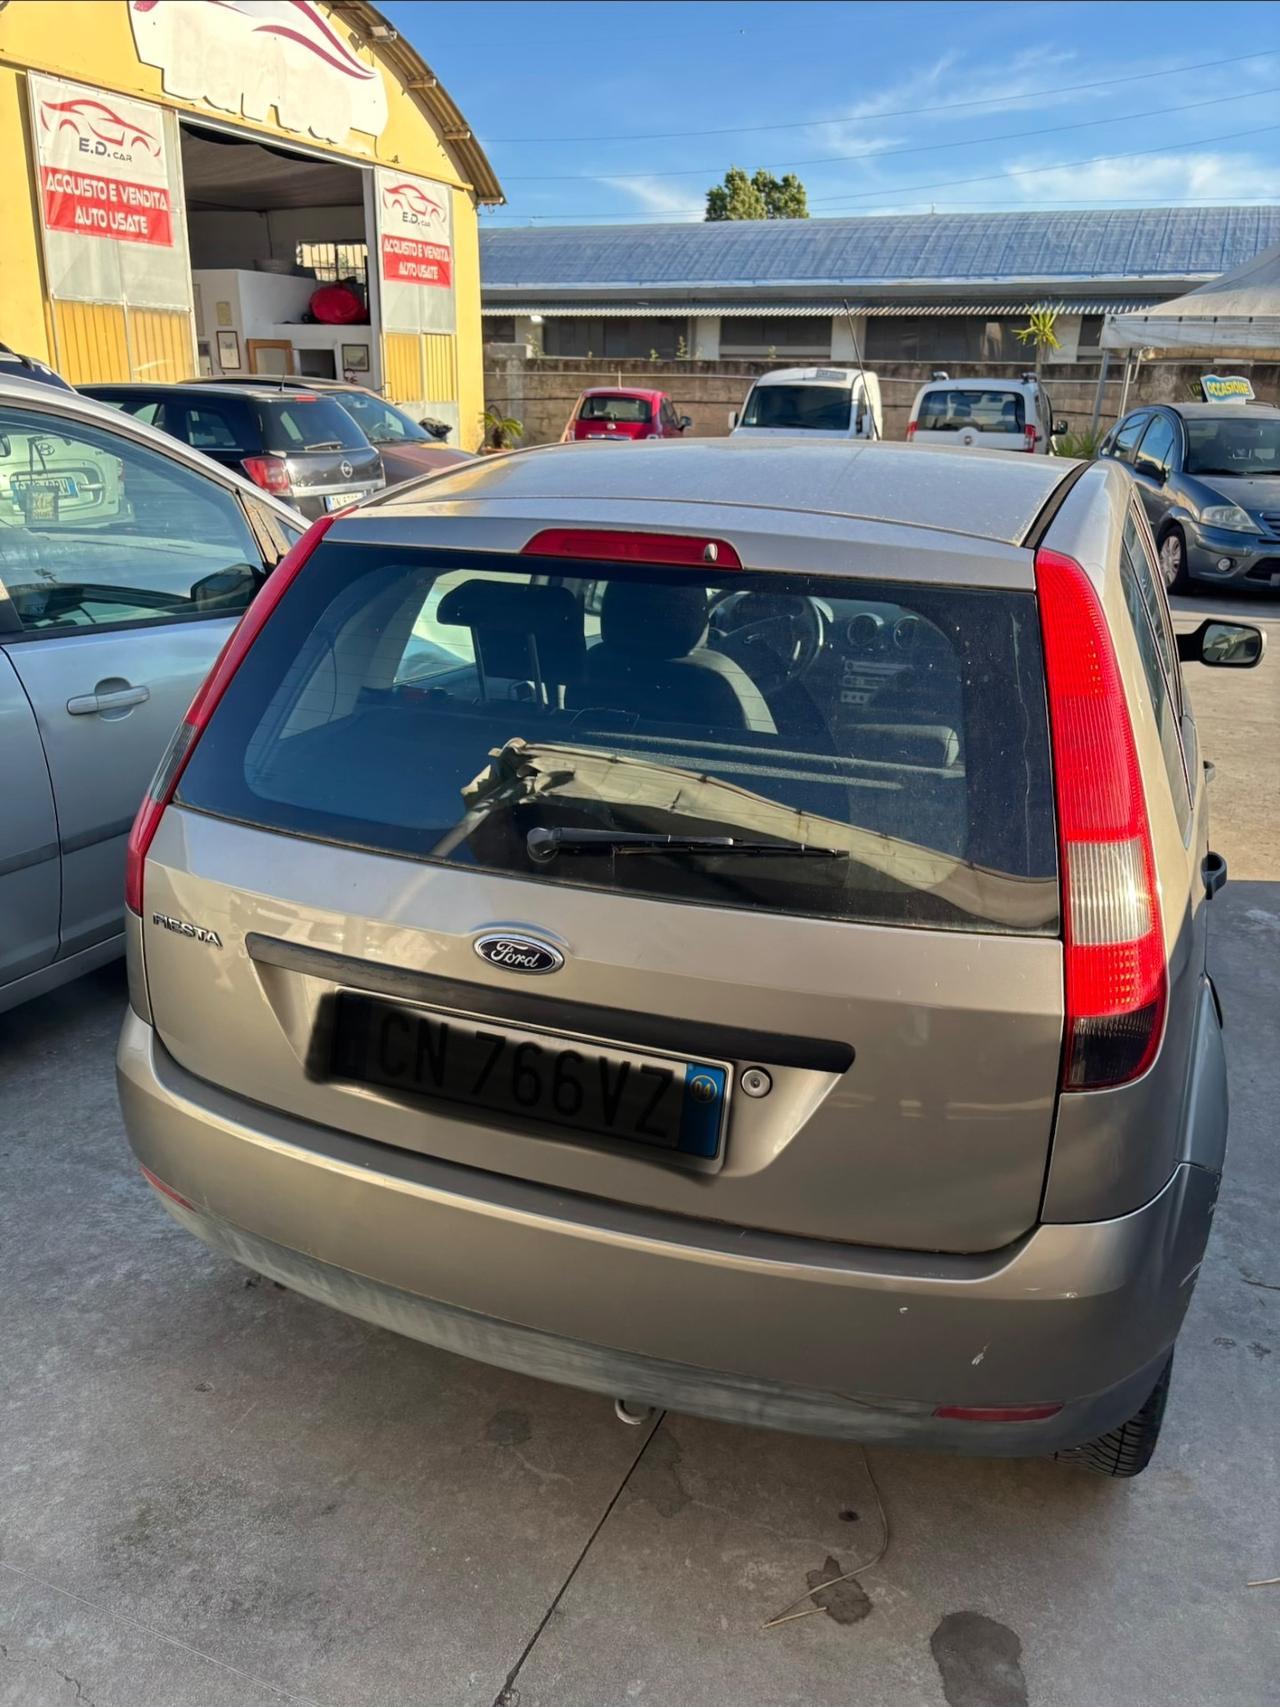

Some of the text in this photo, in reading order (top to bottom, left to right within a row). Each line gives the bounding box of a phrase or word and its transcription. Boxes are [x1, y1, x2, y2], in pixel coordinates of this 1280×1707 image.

[78, 137, 133, 162] E.D. CAR
[46, 172, 168, 211] ACQUISTO E VENDITA
[75, 206, 149, 234] AUTO USATE
[383, 238, 450, 263] ACQUISTO E VENDITA
[398, 261, 440, 281] AUTO USATE
[1206, 380, 1250, 397] OCCASIONE
[153, 912, 223, 950] FIESTA
[490, 941, 540, 968] Ford
